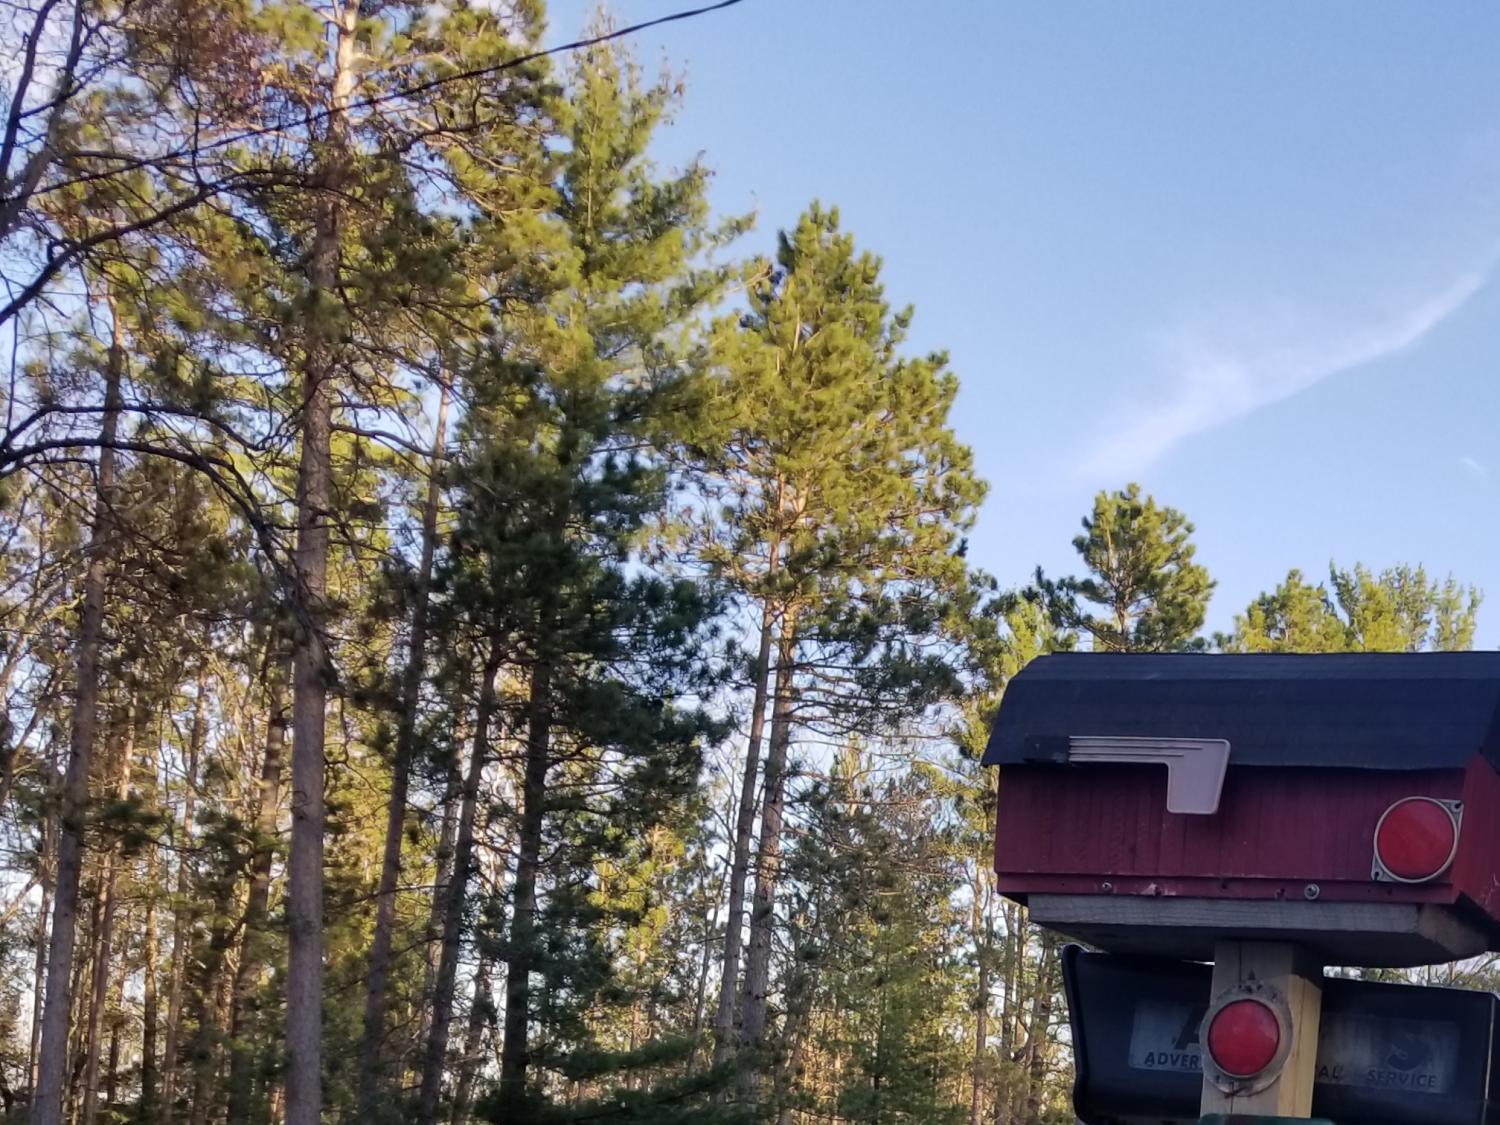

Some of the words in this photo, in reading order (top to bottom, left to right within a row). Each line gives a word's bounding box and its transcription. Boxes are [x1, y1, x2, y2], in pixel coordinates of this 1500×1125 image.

[1144, 1052, 1201, 1070] ADVER
[1315, 1064, 1338, 1078] AL
[1367, 1069, 1437, 1088] SERVICE
